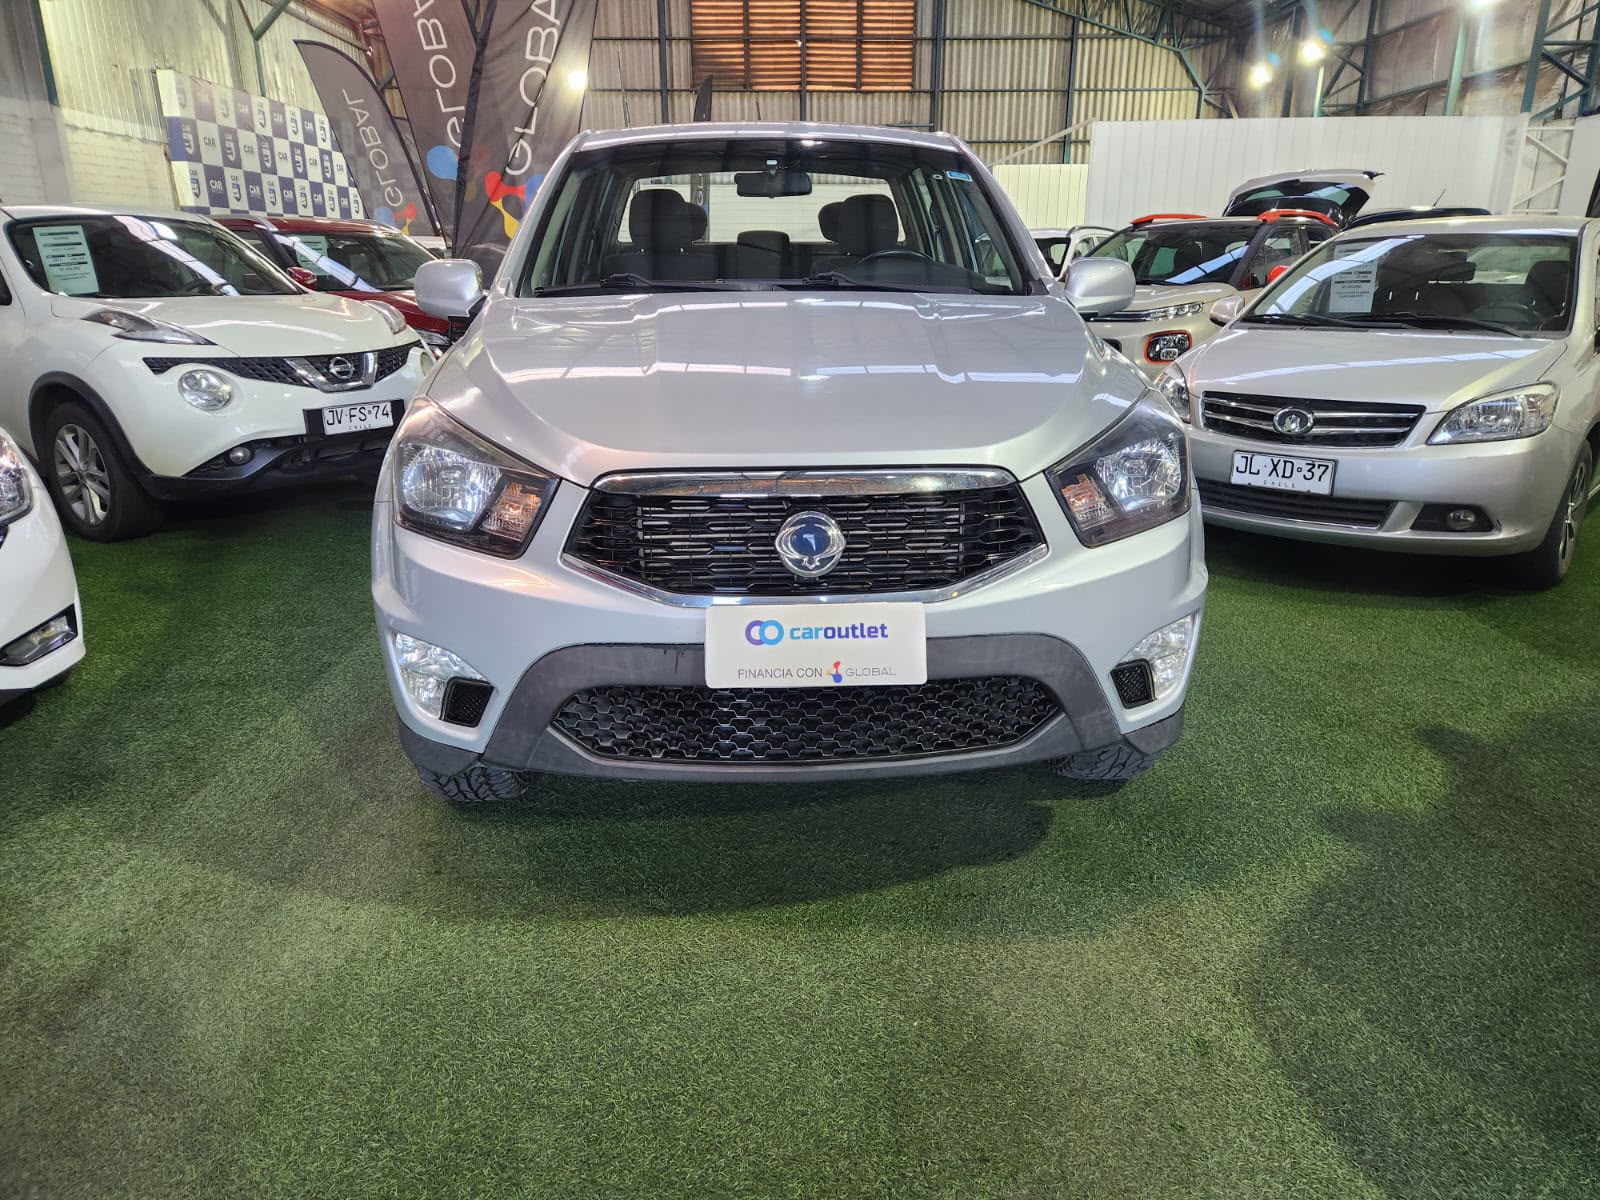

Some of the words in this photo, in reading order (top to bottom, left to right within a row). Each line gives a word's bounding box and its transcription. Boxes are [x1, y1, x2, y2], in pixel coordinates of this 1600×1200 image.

[209, 179, 224, 191] CAR
[789, 622, 888, 640] caroutlet
[737, 667, 793, 680] FINANCIA
[796, 666, 823, 679] CON
[845, 667, 897, 677] GLOBAL
